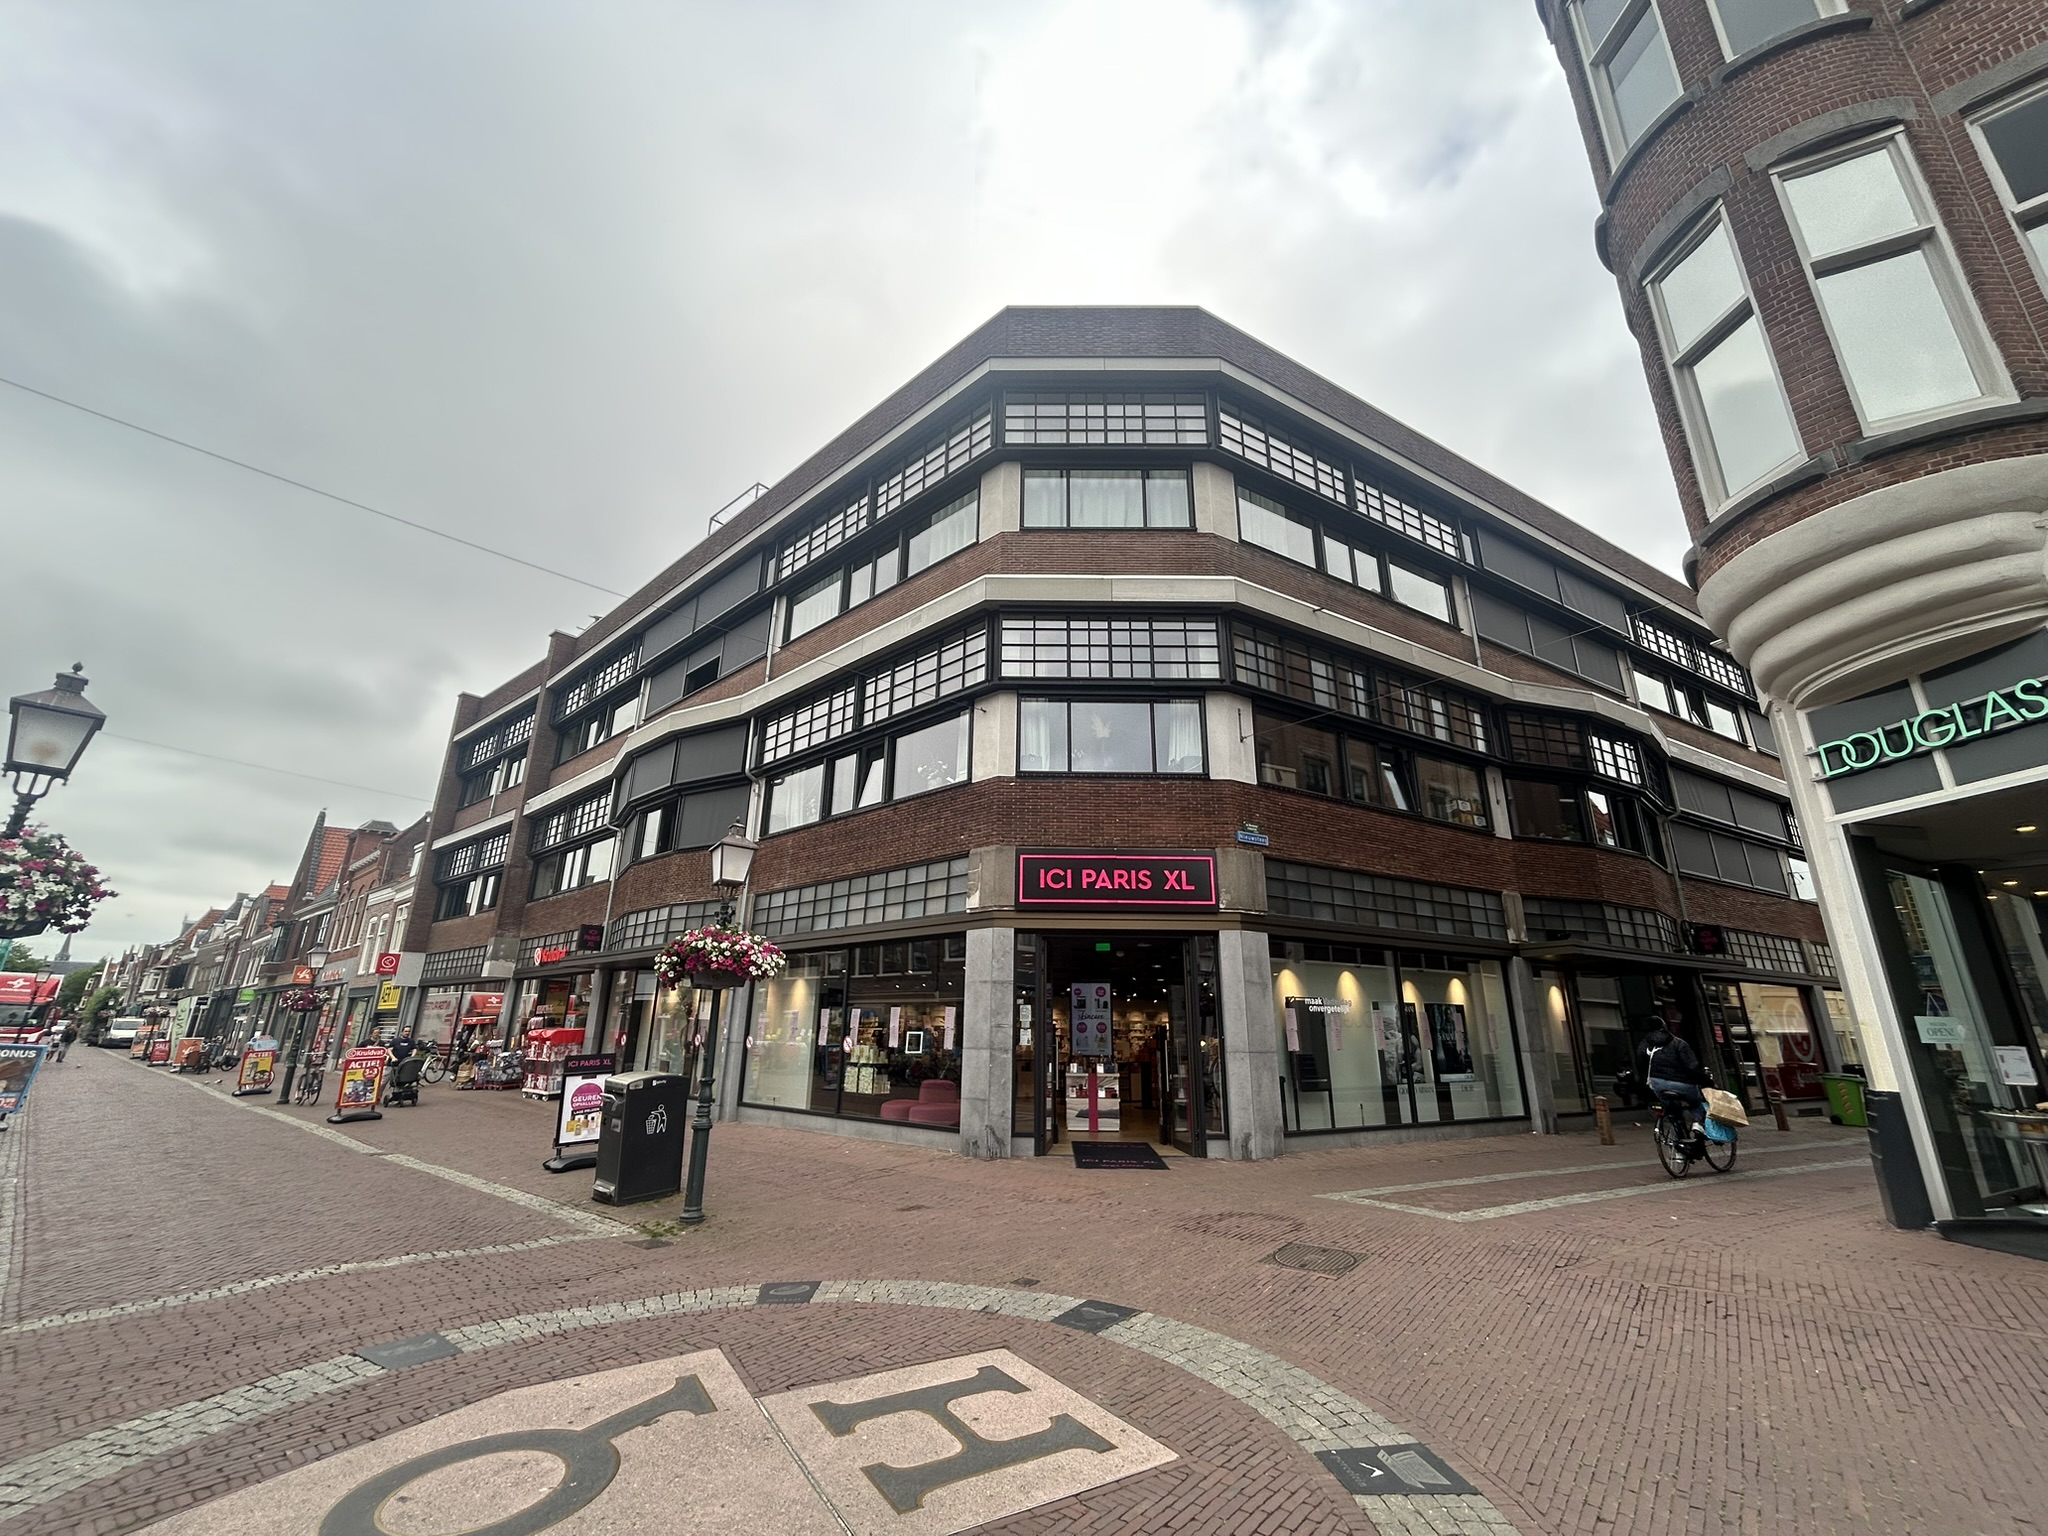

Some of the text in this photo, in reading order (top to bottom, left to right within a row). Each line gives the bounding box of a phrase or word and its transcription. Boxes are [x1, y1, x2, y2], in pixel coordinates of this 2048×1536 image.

[1818, 678, 2048, 777] DOUGLAS
[1039, 868, 1195, 890] ICI PARIS XL
[1304, 997, 1323, 1005] maak
[1308, 1004, 1350, 1014] onvergetelijk
[0, 1049, 37, 1058] ONUS
[348, 1059, 380, 1069] ACTIE!
[567, 1060, 578, 1068] ICI
[580, 1059, 600, 1067] PARIS
